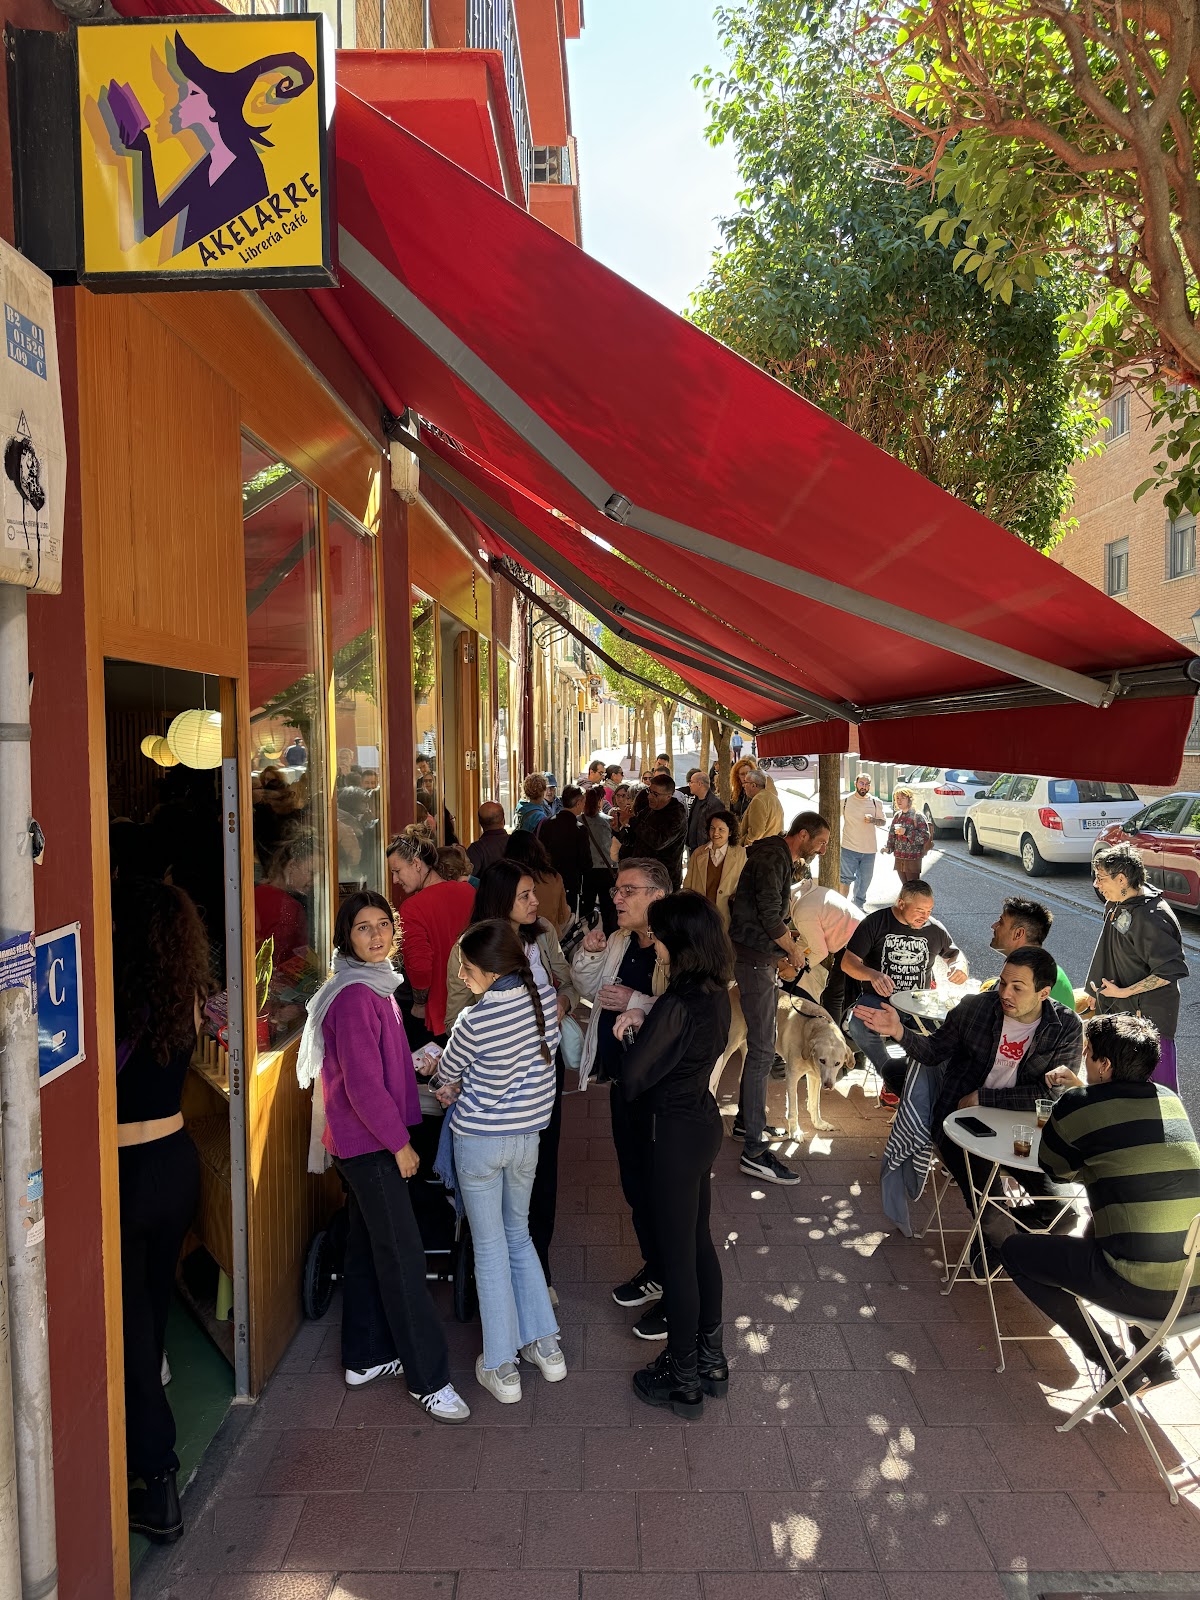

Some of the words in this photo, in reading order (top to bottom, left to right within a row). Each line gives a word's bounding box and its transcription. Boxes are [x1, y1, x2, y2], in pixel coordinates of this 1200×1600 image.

[198, 172, 319, 267] AKELARRE
[238, 231, 283, 263] Librería
[282, 210, 308, 235] Café
[6, 305, 21, 327] B2
[31, 325, 43, 343] 01
[9, 342, 28, 366] L09
[36, 360, 44, 376] C
[13, 329, 44, 359] 01520
[49, 958, 65, 1005] C
[889, 964, 920, 974] GASOLINA
